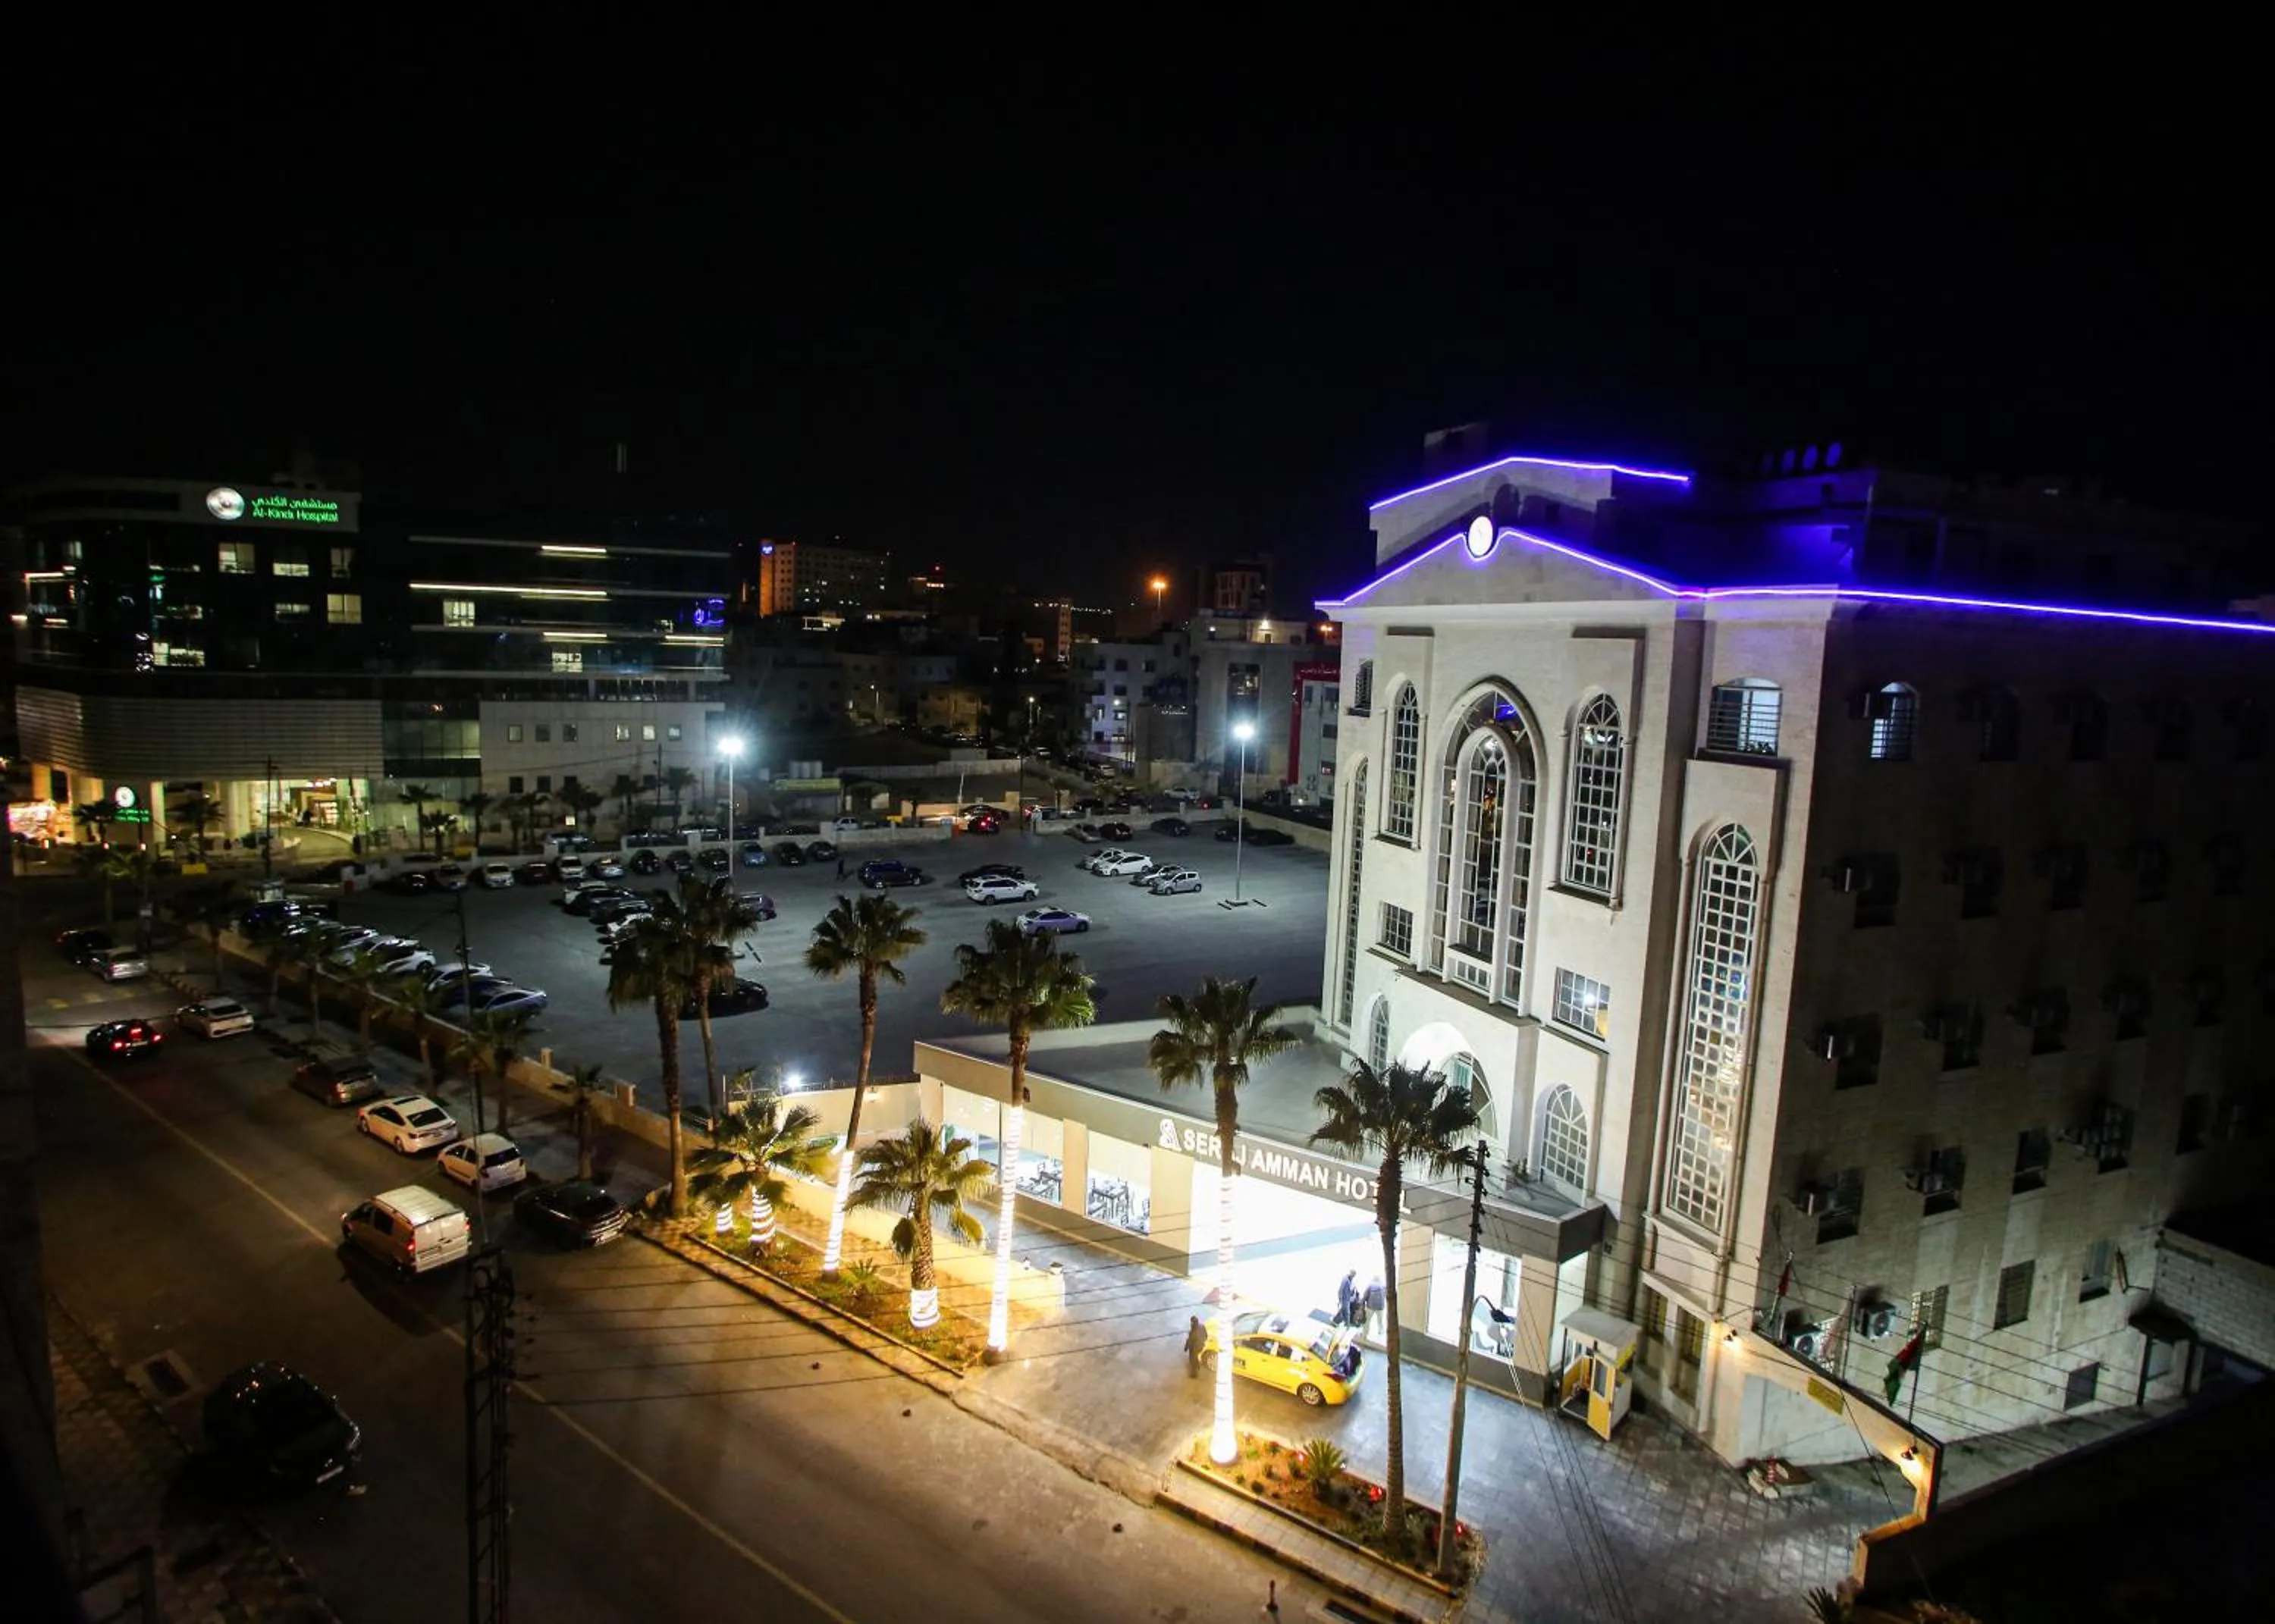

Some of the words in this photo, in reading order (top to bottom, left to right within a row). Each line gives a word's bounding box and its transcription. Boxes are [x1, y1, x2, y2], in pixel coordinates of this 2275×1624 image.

[297, 509, 338, 522] Hospital
[1184, 1128, 1247, 1166] SERJ
[1250, 1149, 1329, 1190] AMMAN
[1335, 1170, 1411, 1215] HOTL
